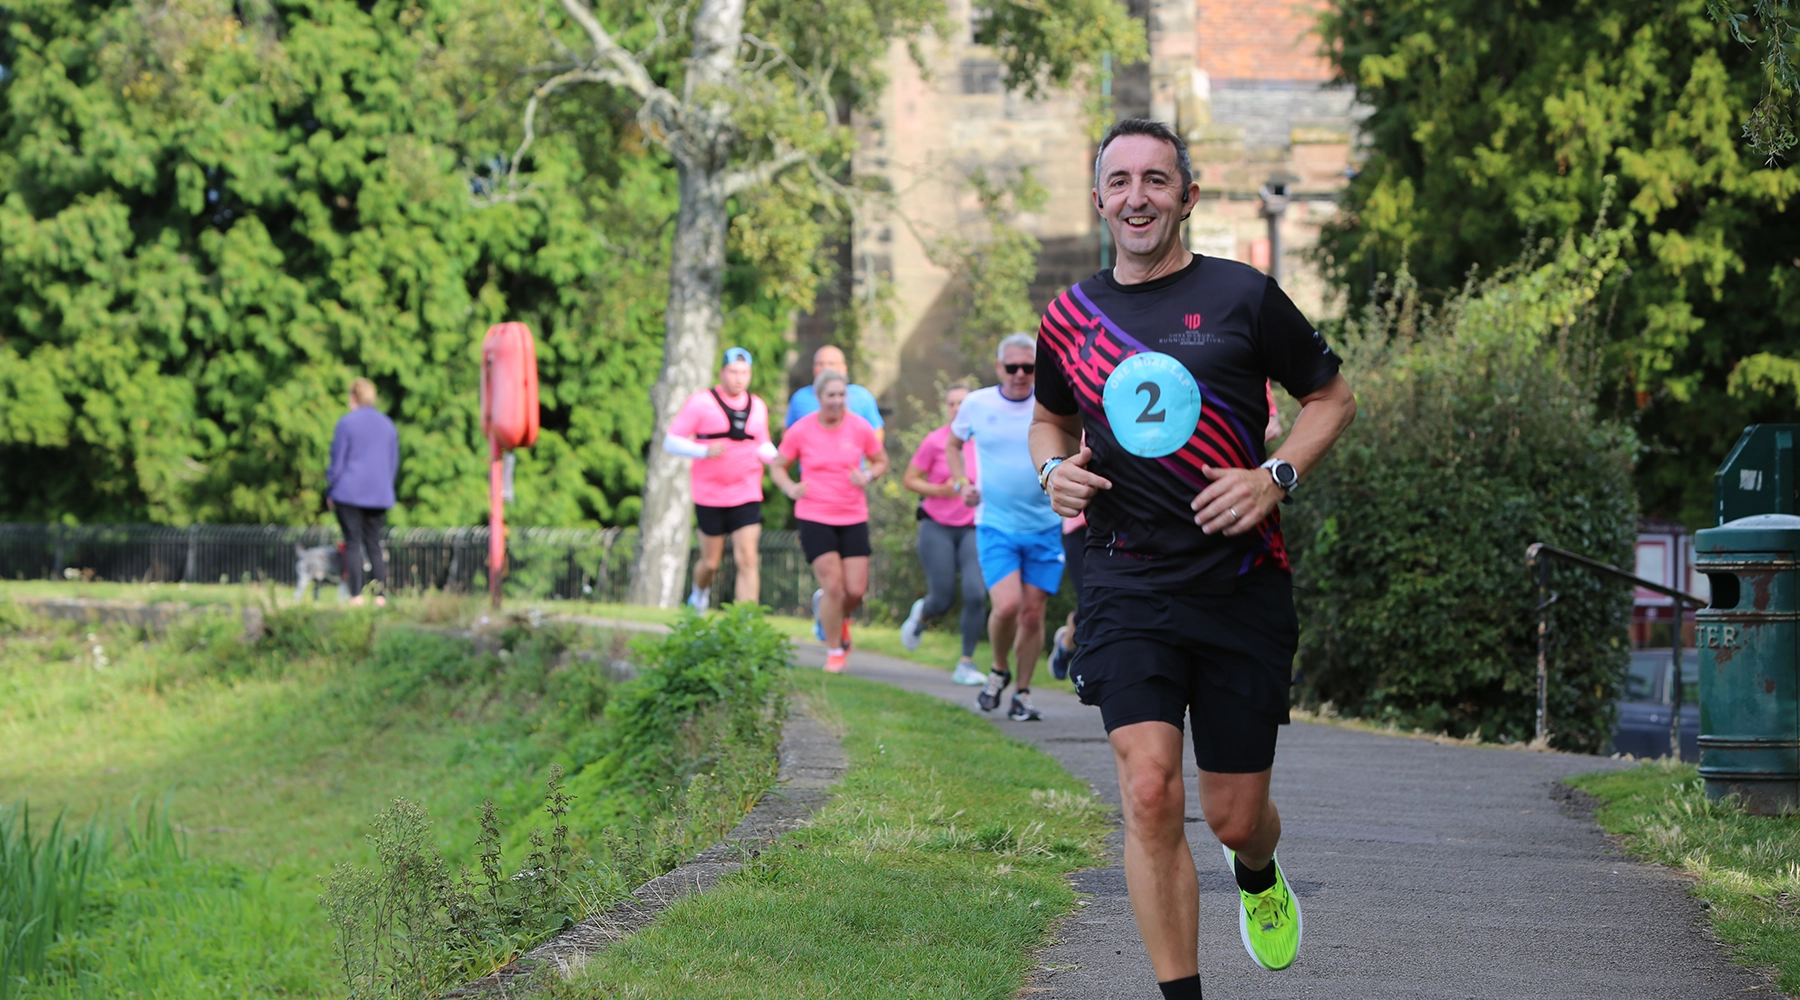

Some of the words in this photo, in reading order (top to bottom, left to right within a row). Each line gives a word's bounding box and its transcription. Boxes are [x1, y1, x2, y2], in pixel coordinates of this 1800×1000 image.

[1110, 365, 1131, 389] ONE
[1133, 356, 1169, 370] MORE
[1135, 381, 1166, 423] 2
